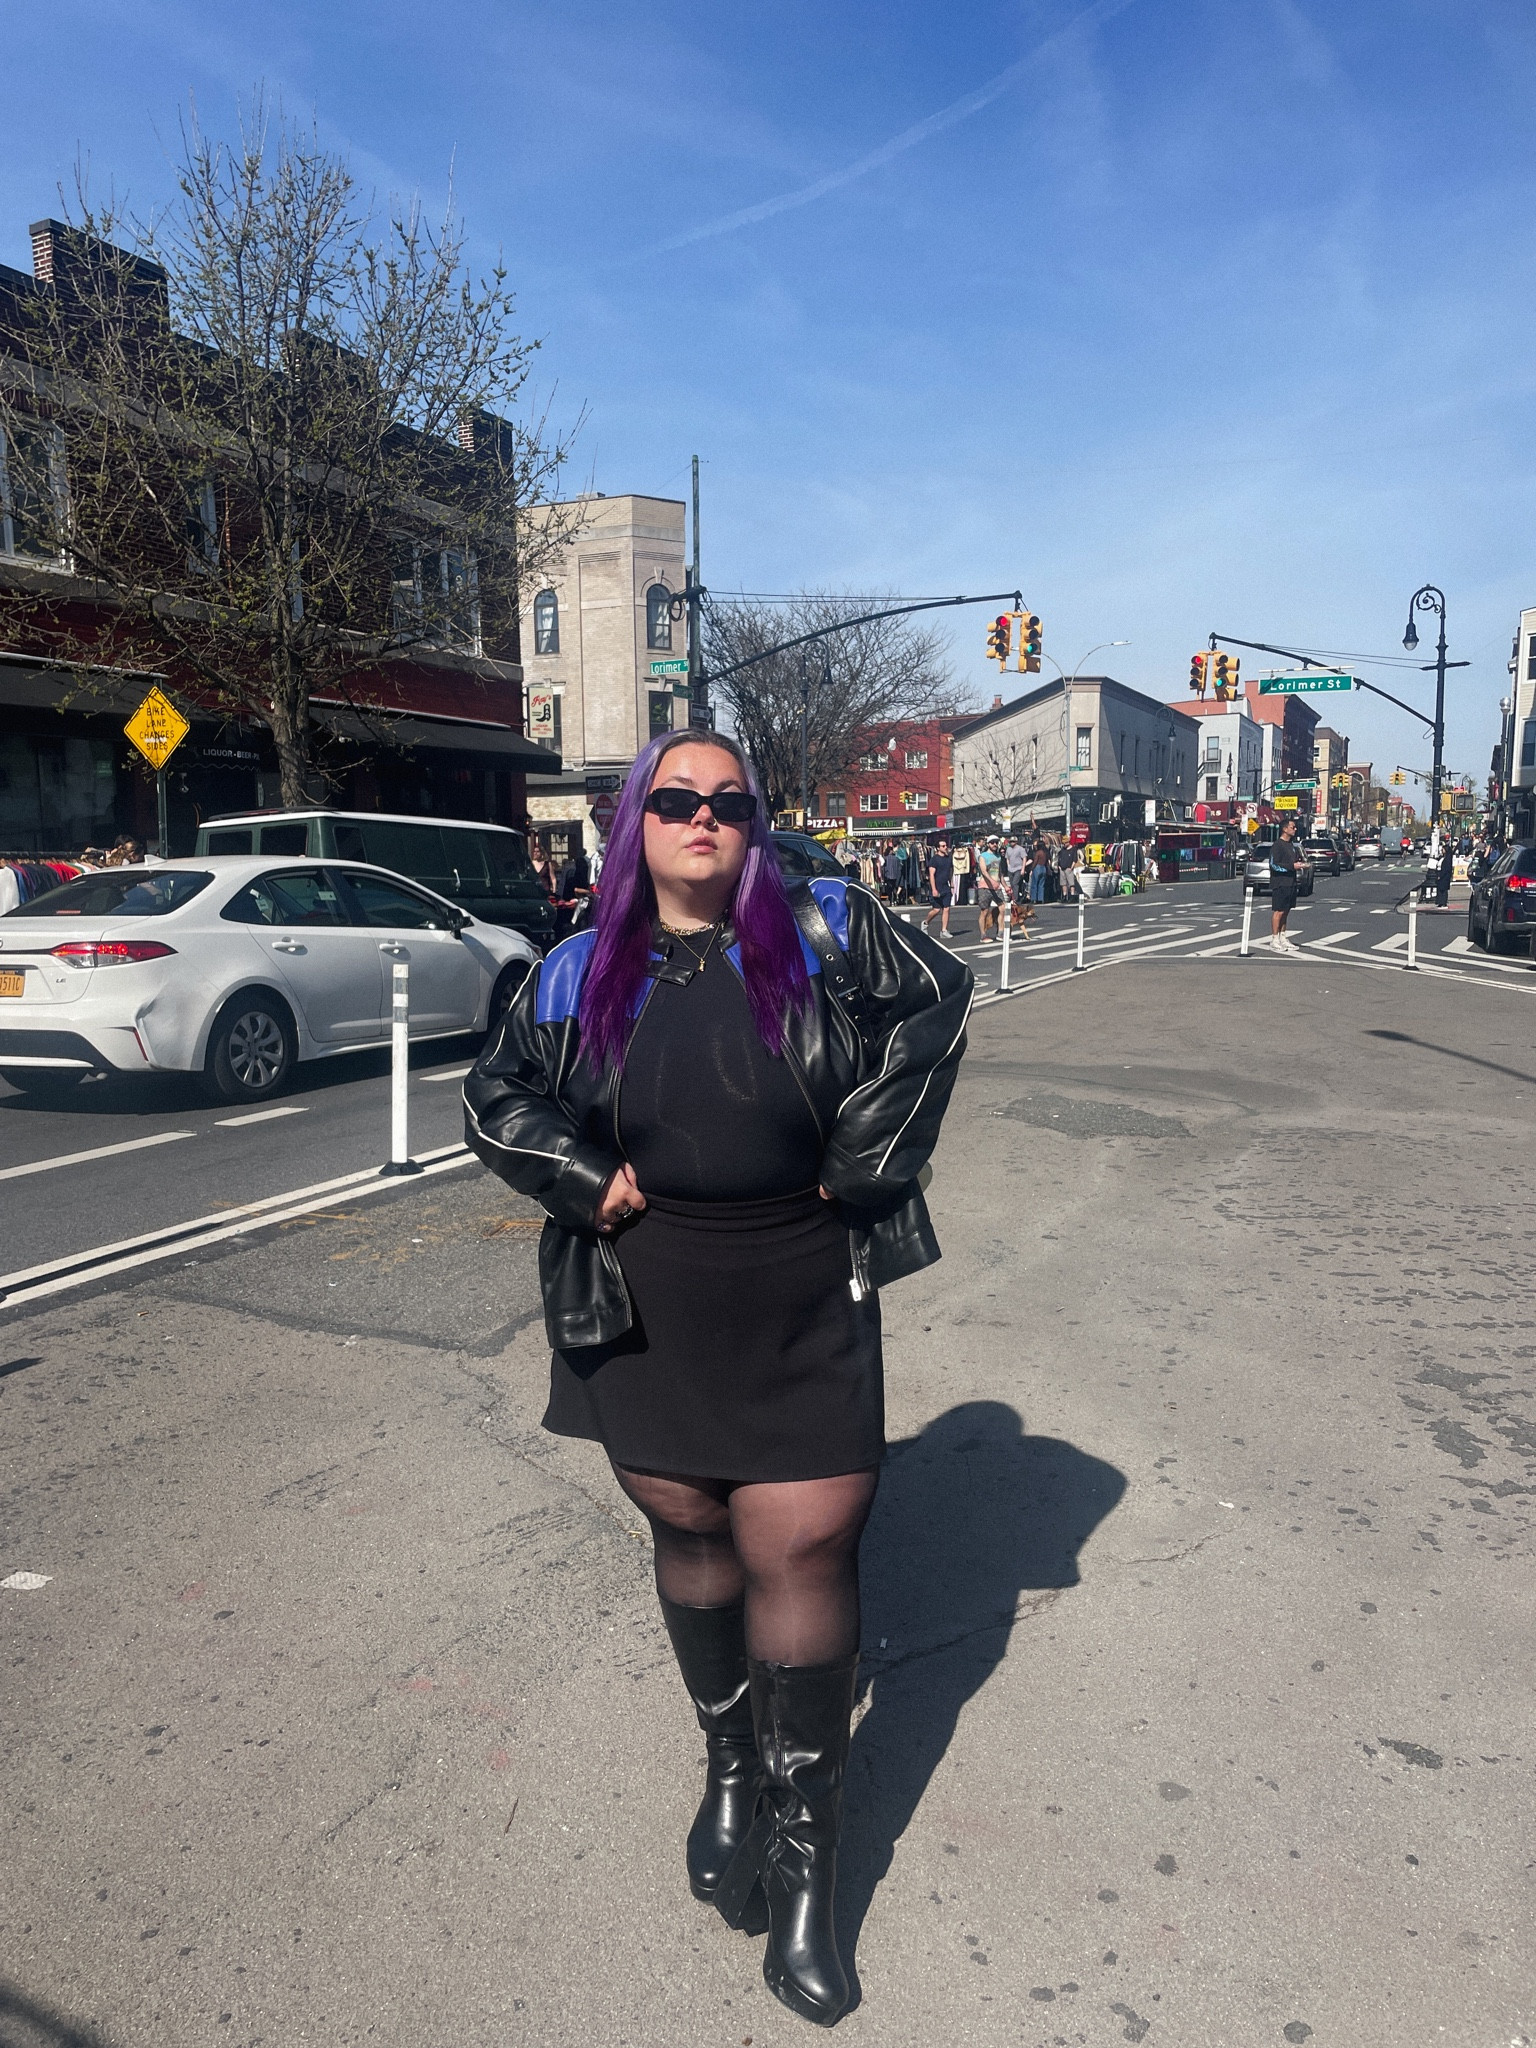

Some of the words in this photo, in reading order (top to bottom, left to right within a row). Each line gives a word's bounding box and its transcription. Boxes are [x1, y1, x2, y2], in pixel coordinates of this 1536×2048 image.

[651, 662, 681, 674] Lorimer
[1270, 680, 1323, 691] Lorimer
[1327, 679, 1341, 689] St
[146, 706, 166, 716] BIKE
[146, 719, 167, 728] LANE
[139, 730, 175, 740] CHANGES
[146, 742, 169, 751] SIDES
[203, 748, 233, 758] LIQUOR
[236, 750, 252, 759] BEER
[806, 819, 838, 828] PIZZA
